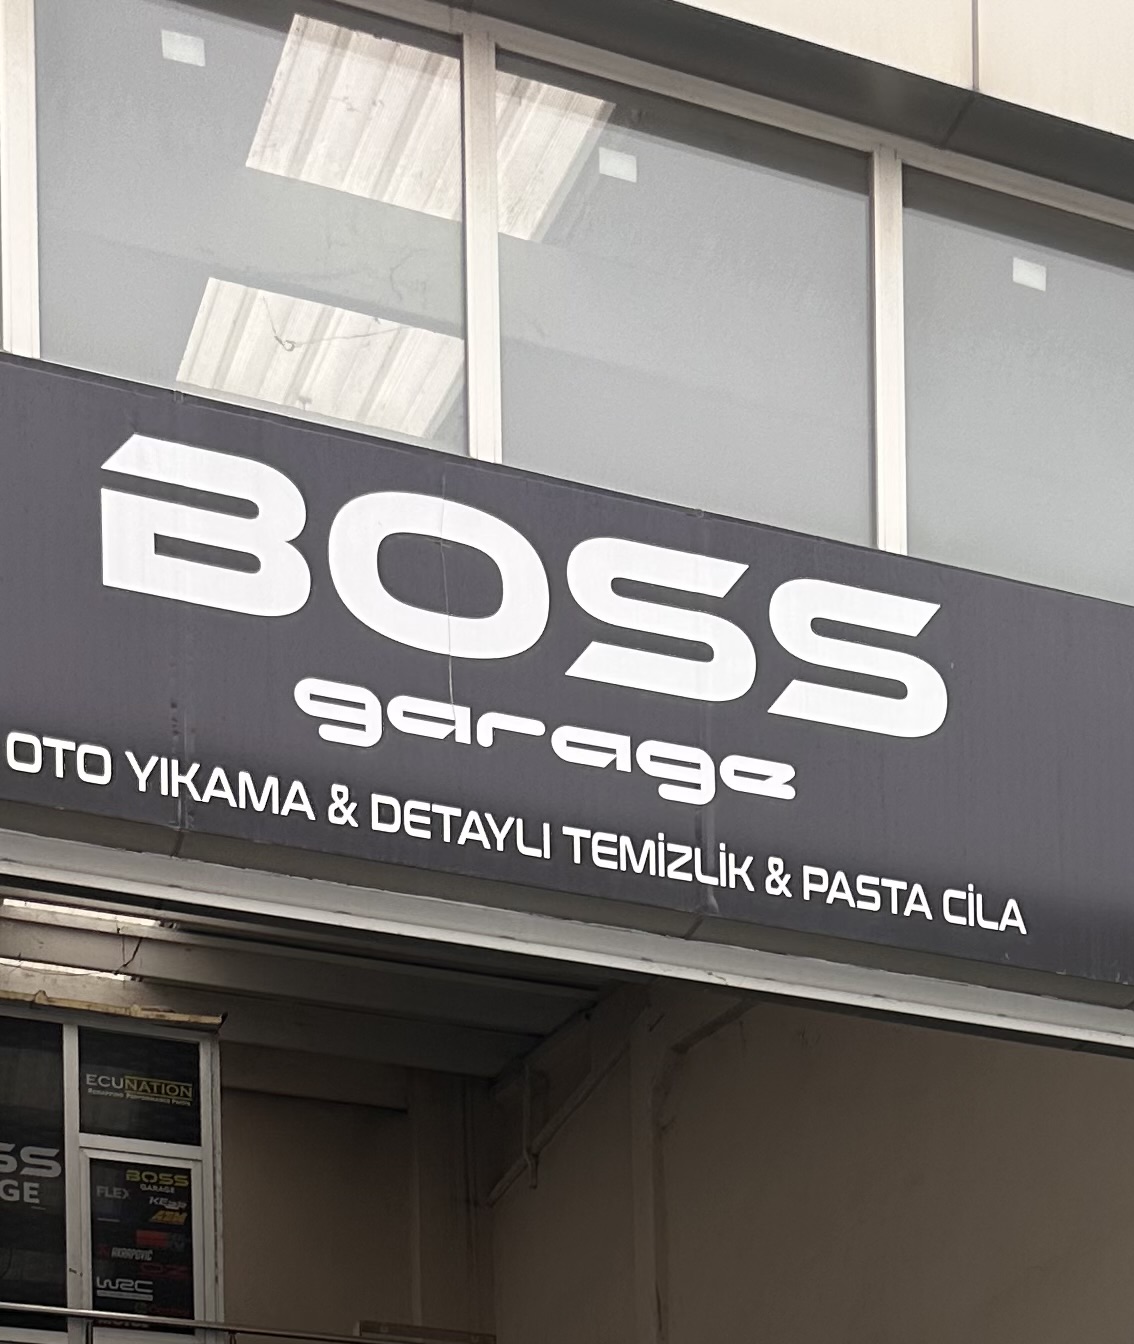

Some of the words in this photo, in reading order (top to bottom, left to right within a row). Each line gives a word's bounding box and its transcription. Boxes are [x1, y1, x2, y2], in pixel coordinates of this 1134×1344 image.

[101, 434, 948, 738] BOSS
[294, 677, 796, 805] garage
[6, 731, 113, 786] OTO
[125, 752, 316, 821] YIKAMA
[330, 784, 358, 826] &
[371, 796, 550, 859] DETAYLI
[563, 827, 755, 893] TEMİZLİK
[765, 857, 791, 897] &
[802, 866, 932, 922] PASTA
[942, 881, 1027, 935] CİLA
[85, 1073, 193, 1098] ECUNATION
[125, 1168, 190, 1188] BOSS
[96, 1276, 154, 1294] WRC
